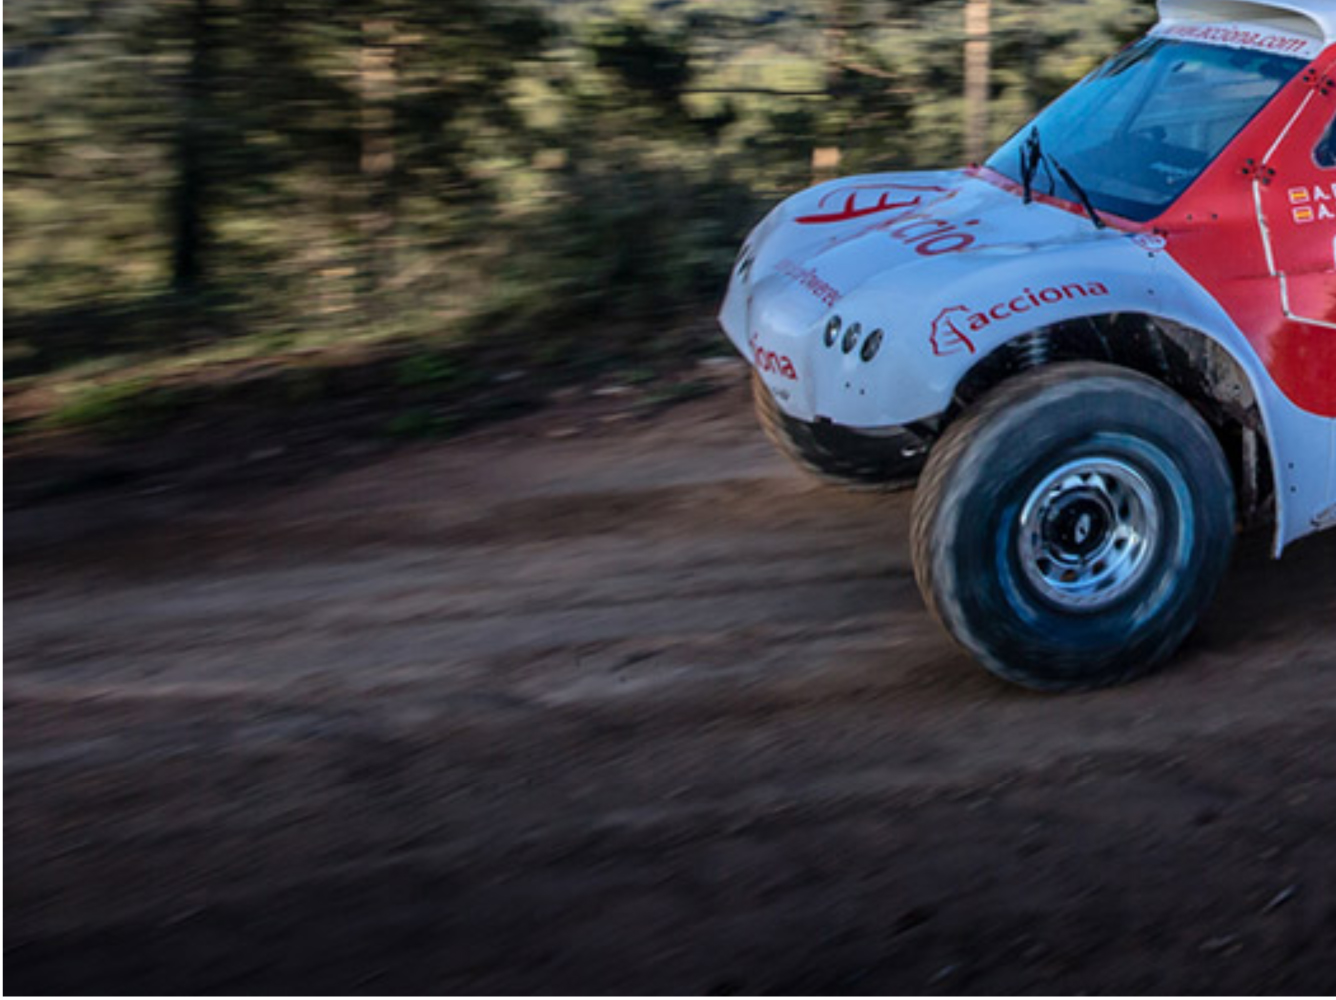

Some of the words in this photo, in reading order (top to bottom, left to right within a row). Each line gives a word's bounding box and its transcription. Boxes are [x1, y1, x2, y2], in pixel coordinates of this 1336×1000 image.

[1313, 184, 1331, 201] A.
[1318, 203, 1335, 220] A.
[967, 280, 1109, 331] acciona
